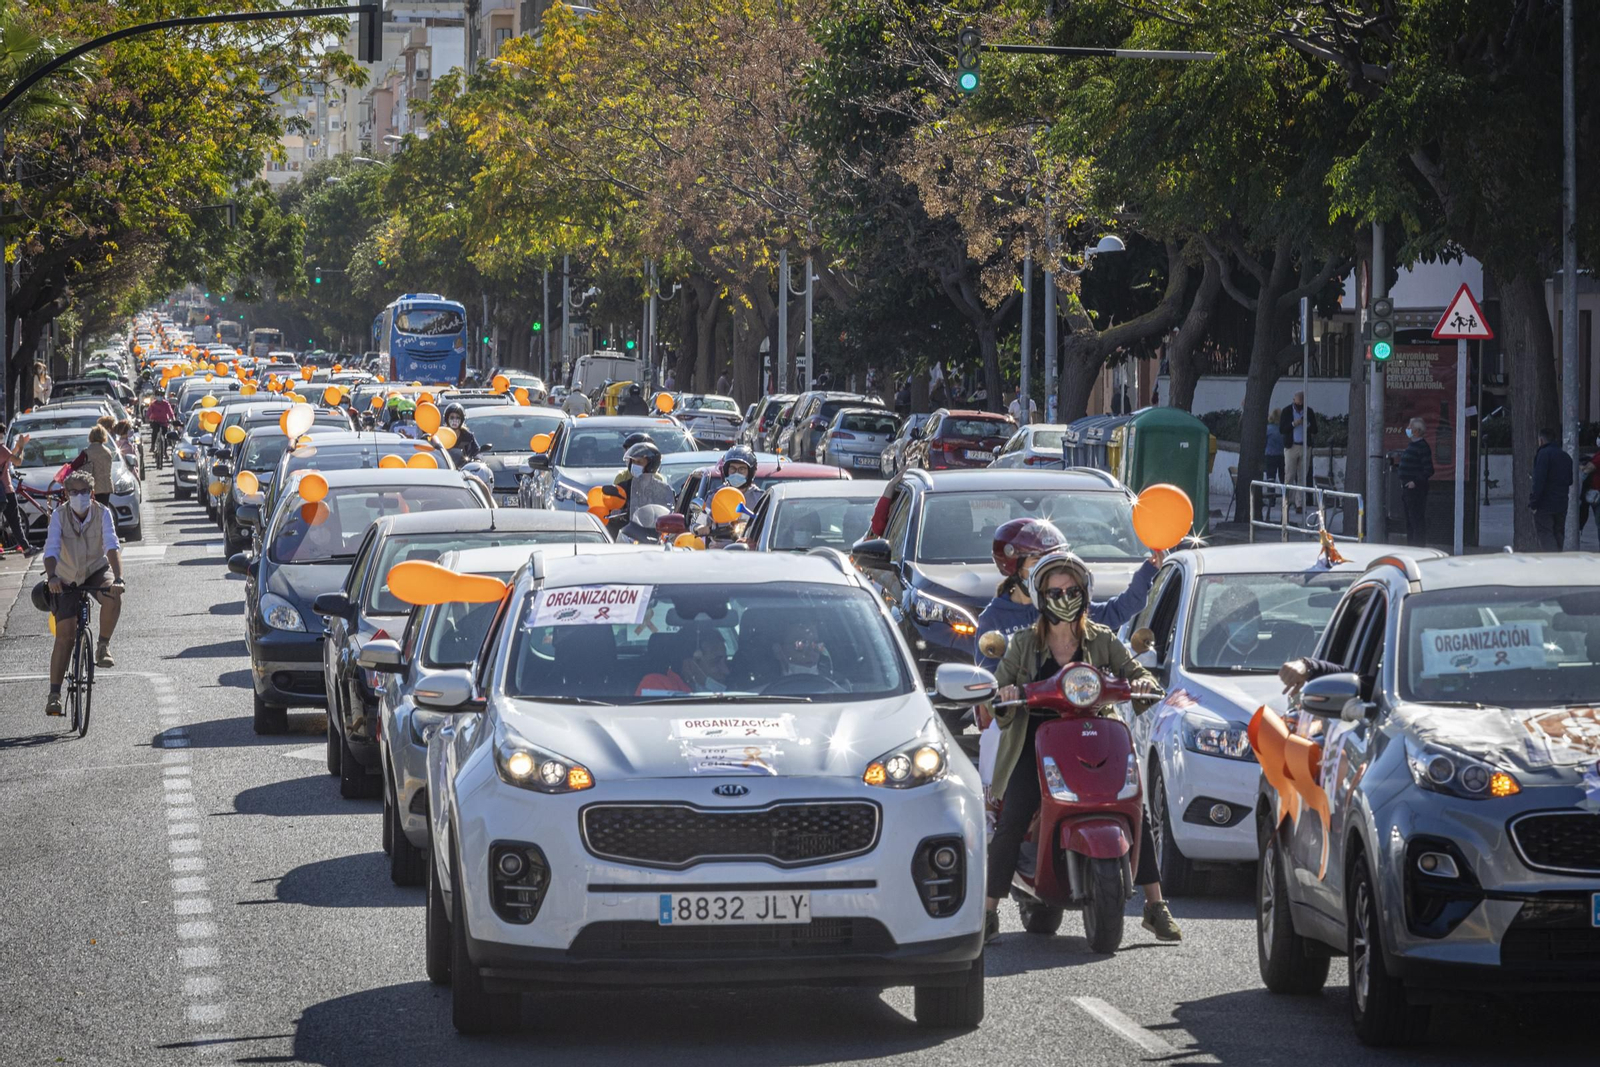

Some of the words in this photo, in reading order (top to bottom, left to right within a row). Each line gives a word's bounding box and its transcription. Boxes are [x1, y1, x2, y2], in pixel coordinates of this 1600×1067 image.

[1396, 352, 1425, 360] MAYORÍA
[546, 587, 639, 607] ORGANIZACIÓN
[1435, 625, 1531, 652] ORGANIZACIÓN
[719, 785, 745, 794] KIA
[663, 912, 669, 920] E
[678, 896, 745, 920] 8832
[756, 895, 804, 919] JLY
